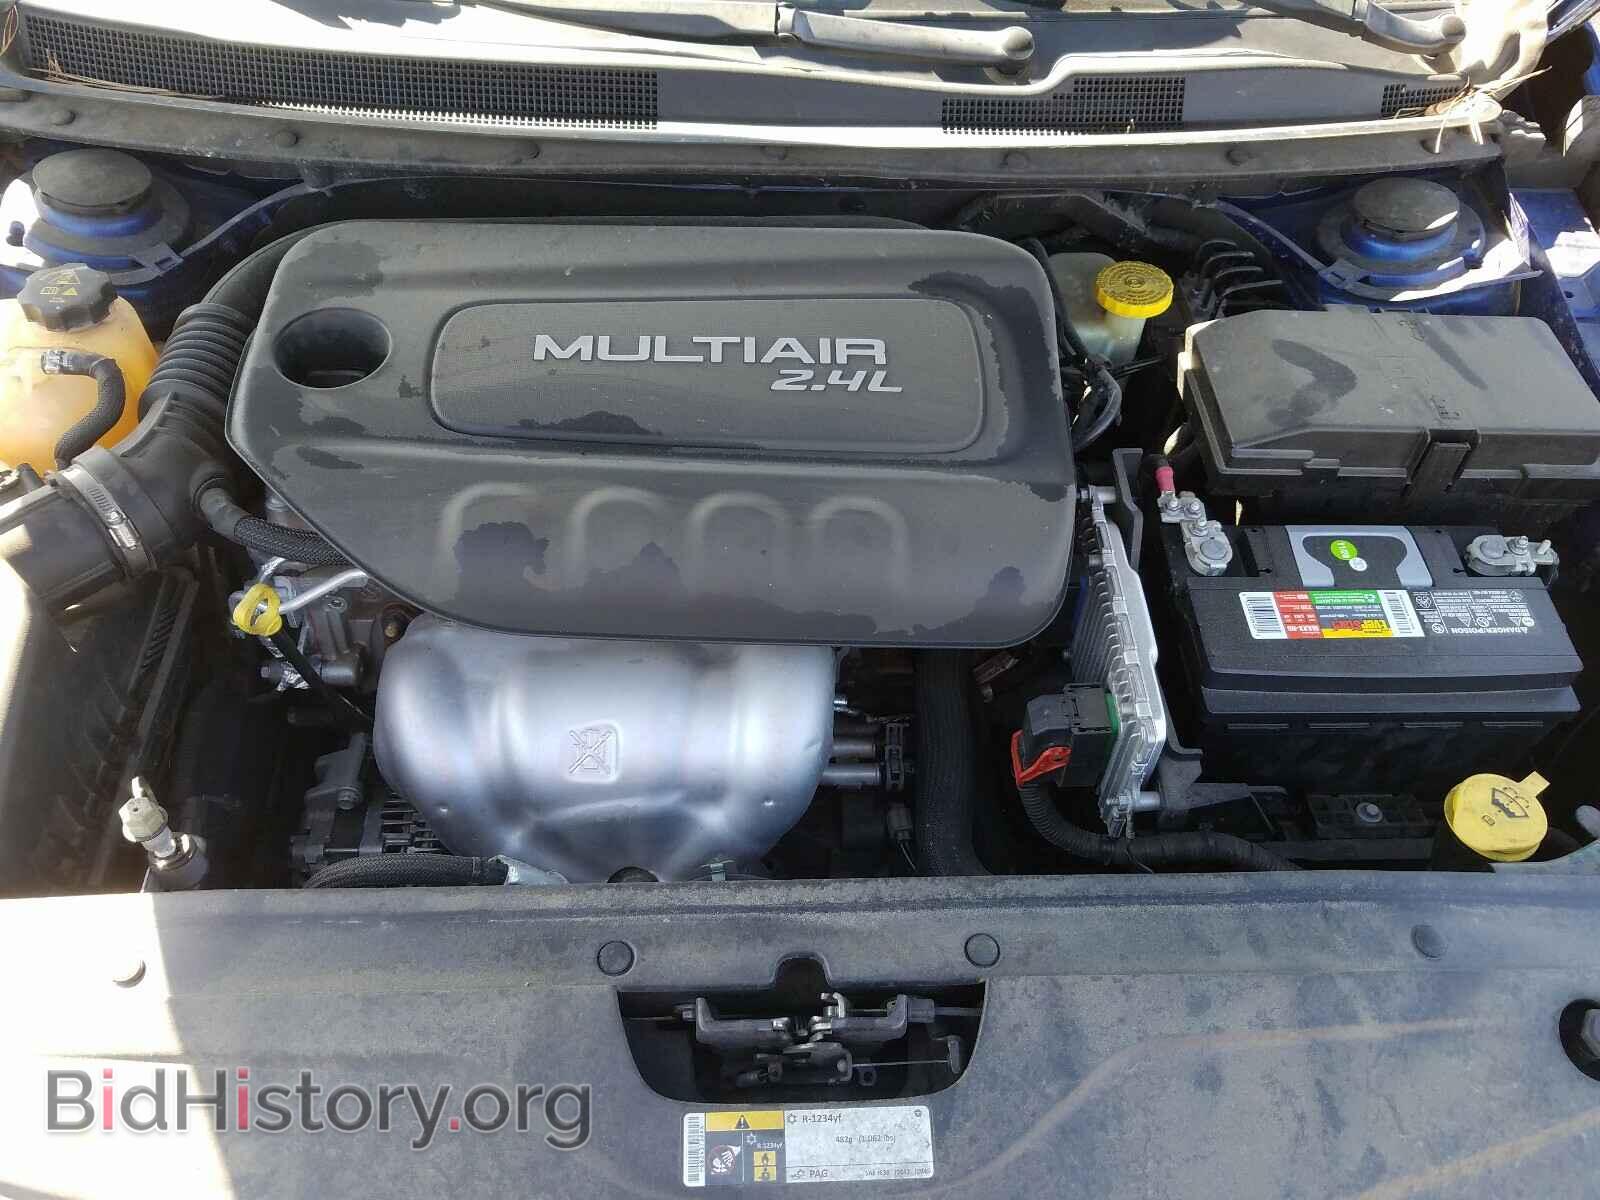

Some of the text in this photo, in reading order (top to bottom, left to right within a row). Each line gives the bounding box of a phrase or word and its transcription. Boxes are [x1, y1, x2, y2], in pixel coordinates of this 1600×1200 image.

[533, 333, 888, 365] MULTIAIR
[770, 369, 903, 393] 2.4L
[802, 1113, 842, 1125] R-1234yf
[808, 1169, 829, 1178] PAG
